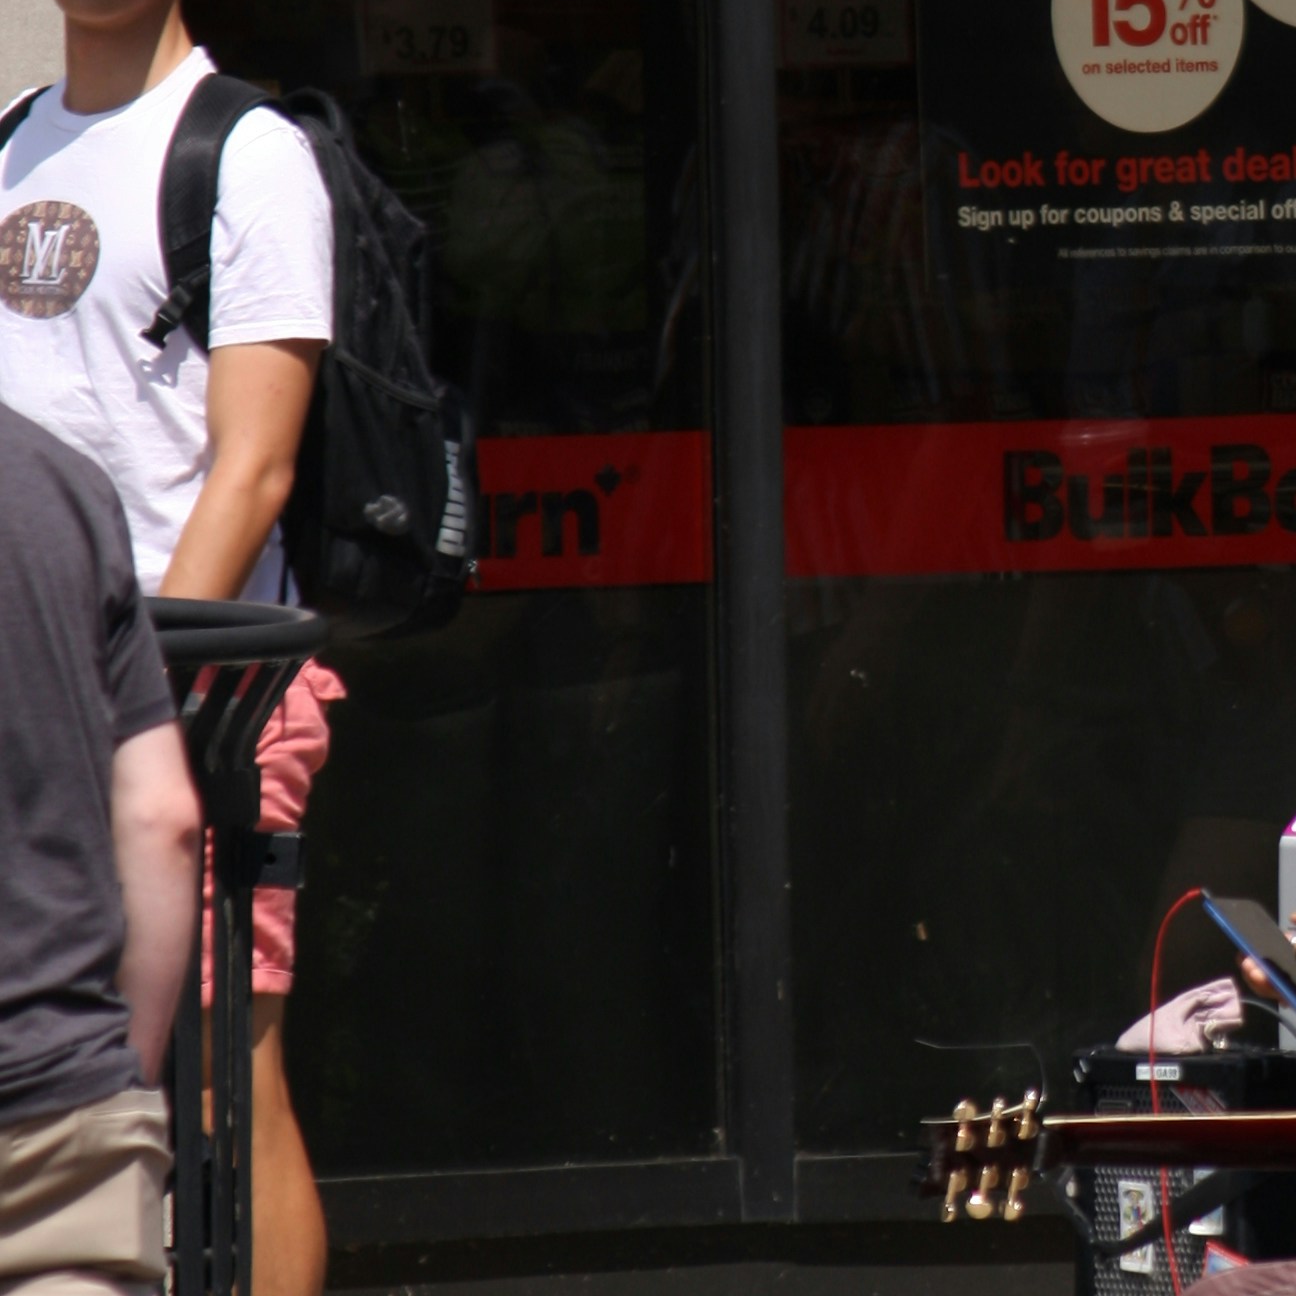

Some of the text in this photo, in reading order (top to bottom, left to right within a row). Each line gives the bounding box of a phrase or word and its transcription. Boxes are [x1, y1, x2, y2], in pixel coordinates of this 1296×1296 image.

[1082, 58, 1219, 75] on selected items
[957, 150, 1046, 188] Look
[1055, 148, 1107, 186] for
[1115, 147, 1212, 193] great
[957, 205, 1002, 231] Sign
[1008, 208, 1035, 229] up
[1040, 203, 1069, 224] for
[1074, 205, 1162, 227] coupons
[1168, 200, 1185, 222] &
[1190, 200, 1265, 225] special
[1127, 246, 1161, 259] savings
[1219, 244, 1273, 257] comparison
[1273, 244, 1283, 254] to
